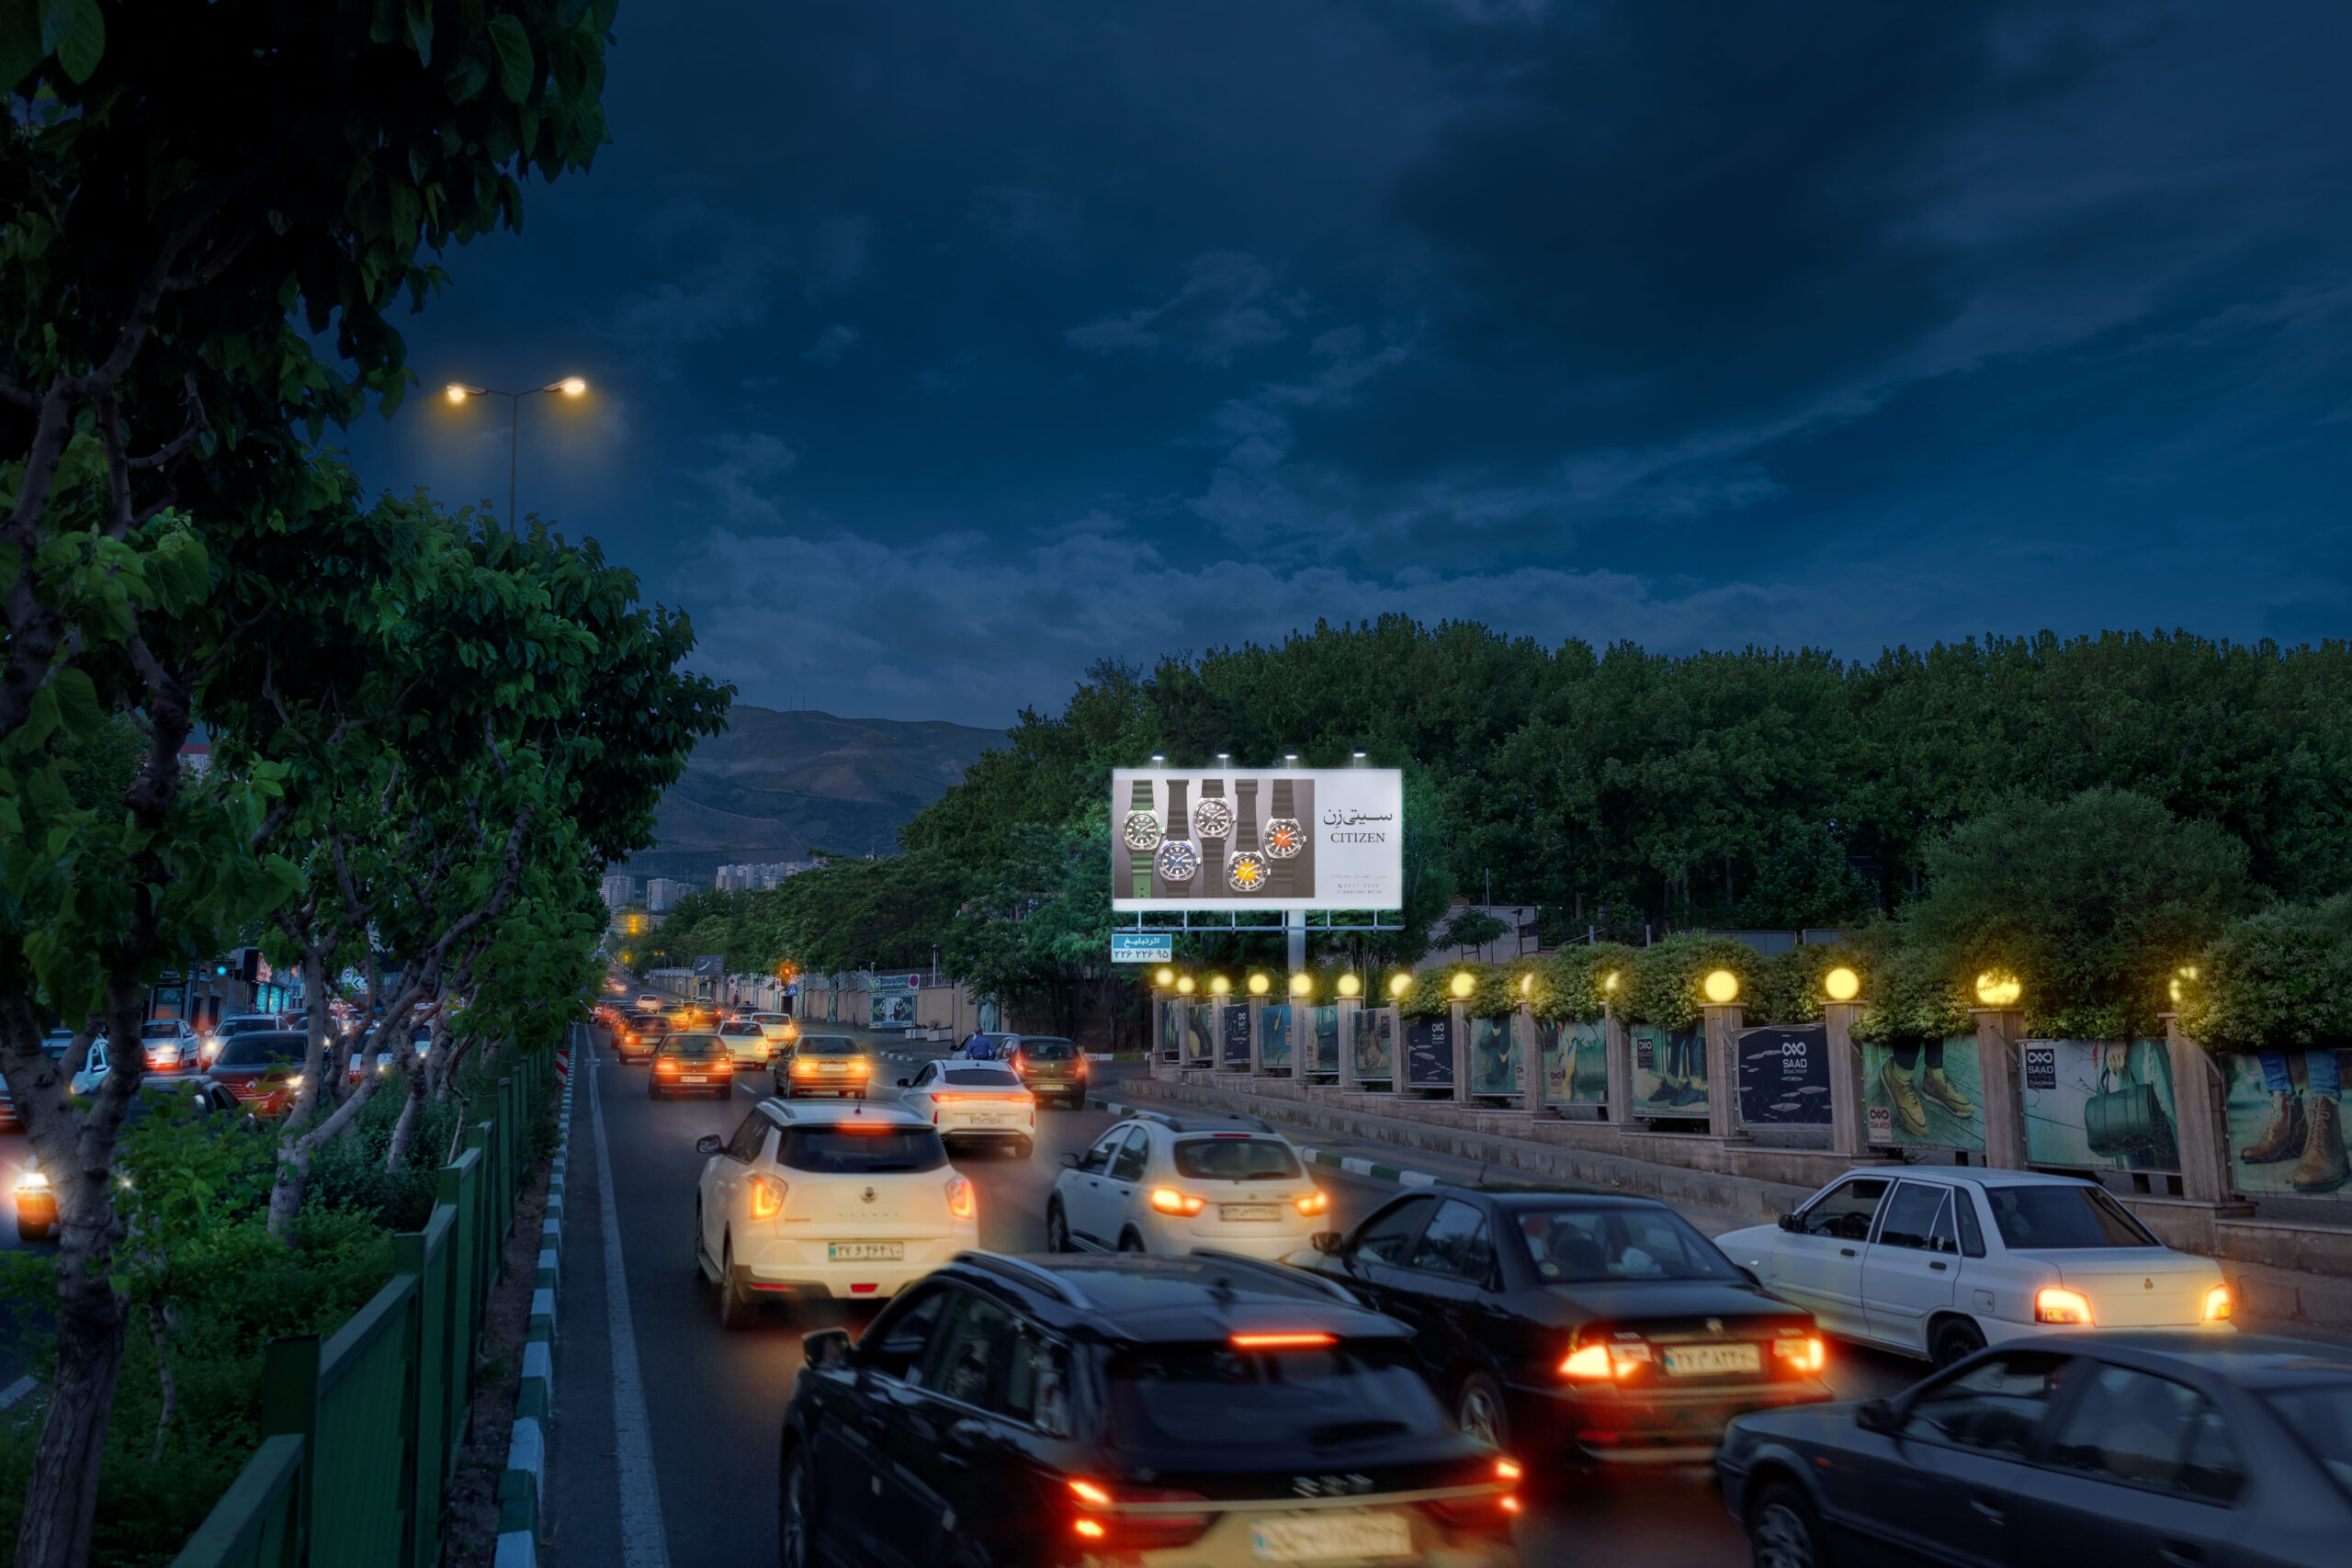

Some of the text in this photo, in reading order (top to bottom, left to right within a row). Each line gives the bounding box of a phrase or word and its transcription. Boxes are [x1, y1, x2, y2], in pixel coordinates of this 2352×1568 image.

[1330, 832, 1385, 843] CITIZEN
[1114, 950, 1169, 958] ۲۲۶ ۲۲۶ ۹۵
[1782, 1058, 1807, 1068] SAAD
[2028, 1066, 2053, 1074] SAAD
